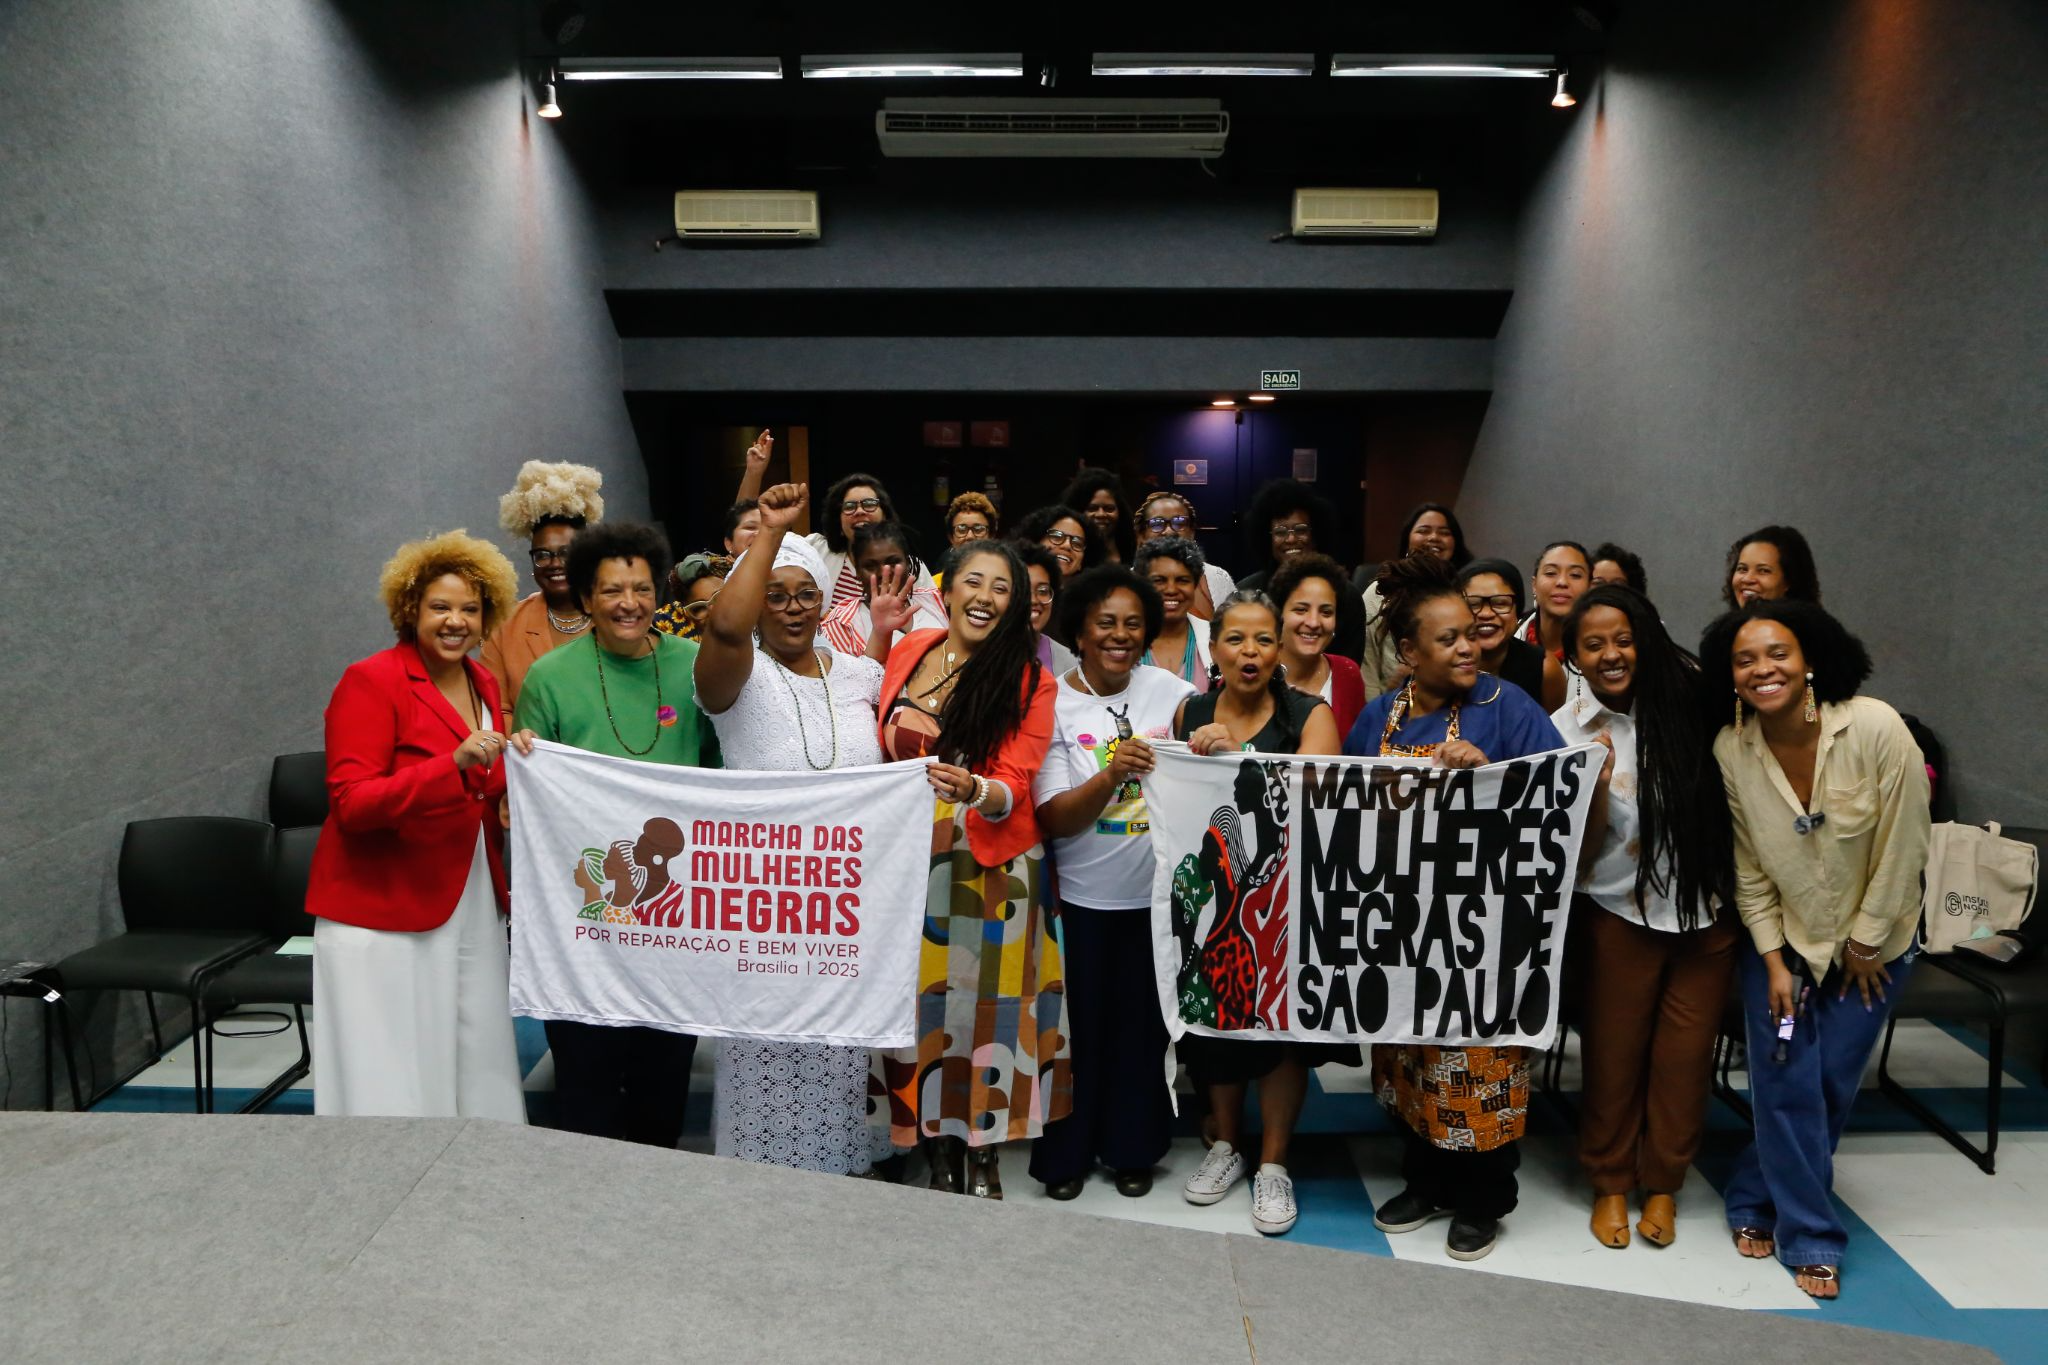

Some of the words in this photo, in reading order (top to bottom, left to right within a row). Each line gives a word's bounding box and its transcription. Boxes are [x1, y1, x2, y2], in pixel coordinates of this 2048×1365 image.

[1264, 371, 1297, 384] SAÍDA
[1302, 762, 1474, 810] MARCHA
[1498, 751, 1586, 810] DAS
[692, 819, 802, 851] MARCHA
[813, 825, 863, 853] DAS
[1301, 808, 1571, 895] MULHERES
[691, 850, 862, 889] MULHERES
[691, 886, 861, 937] NEGRAS
[1298, 891, 1487, 969] NEGRAS
[1500, 892, 1560, 969] DE
[575, 926, 611, 944] POR
[618, 932, 731, 954] REPARAÇÃO
[739, 940, 750, 954] E
[758, 941, 796, 956] BEM
[804, 942, 859, 958] VIVER
[737, 958, 798, 975] Brasília
[817, 961, 859, 978] 2025
[1297, 963, 1389, 1034] SÃO
[1412, 965, 1550, 1039] PAULO
